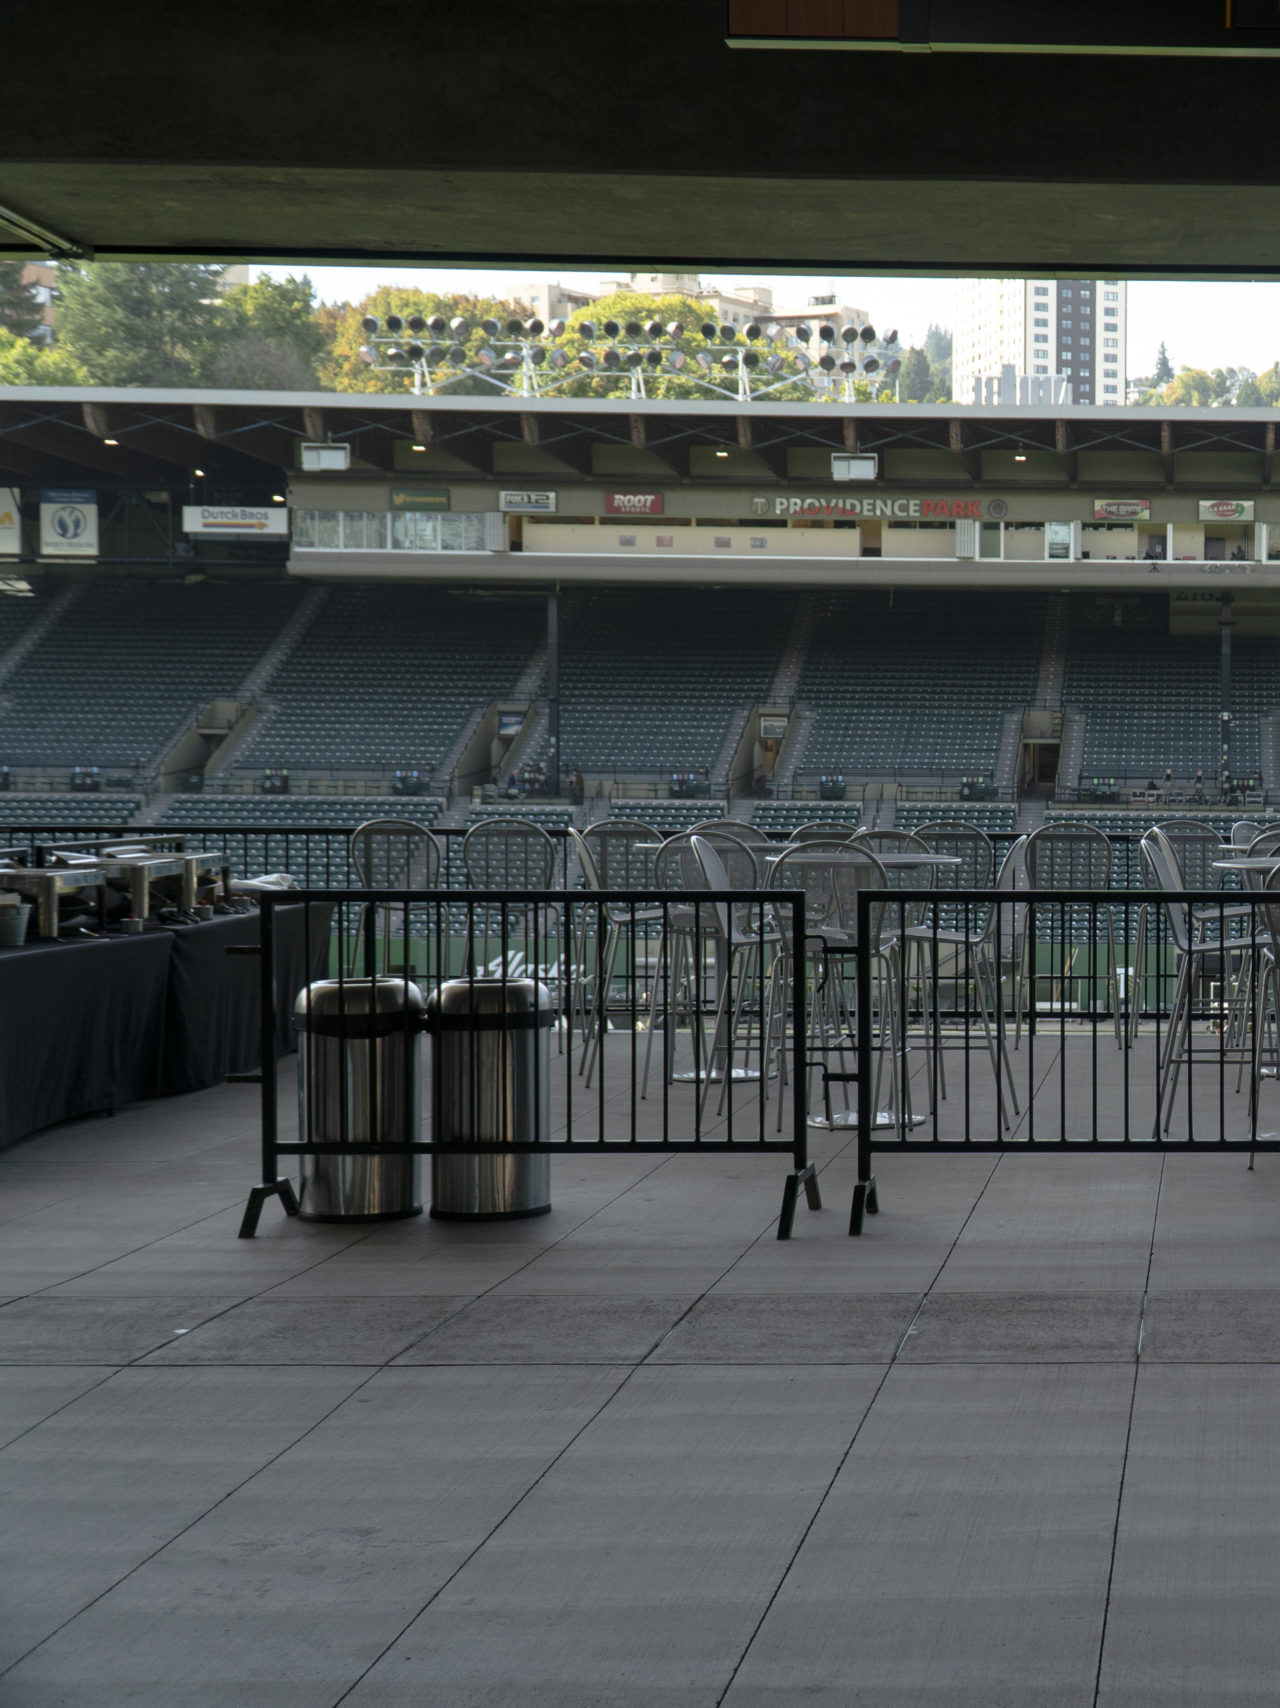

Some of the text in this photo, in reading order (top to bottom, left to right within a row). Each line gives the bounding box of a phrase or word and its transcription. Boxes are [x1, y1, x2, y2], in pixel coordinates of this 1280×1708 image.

[613, 494, 655, 507] ROOT
[775, 498, 982, 518] PROVIDENCE PARK
